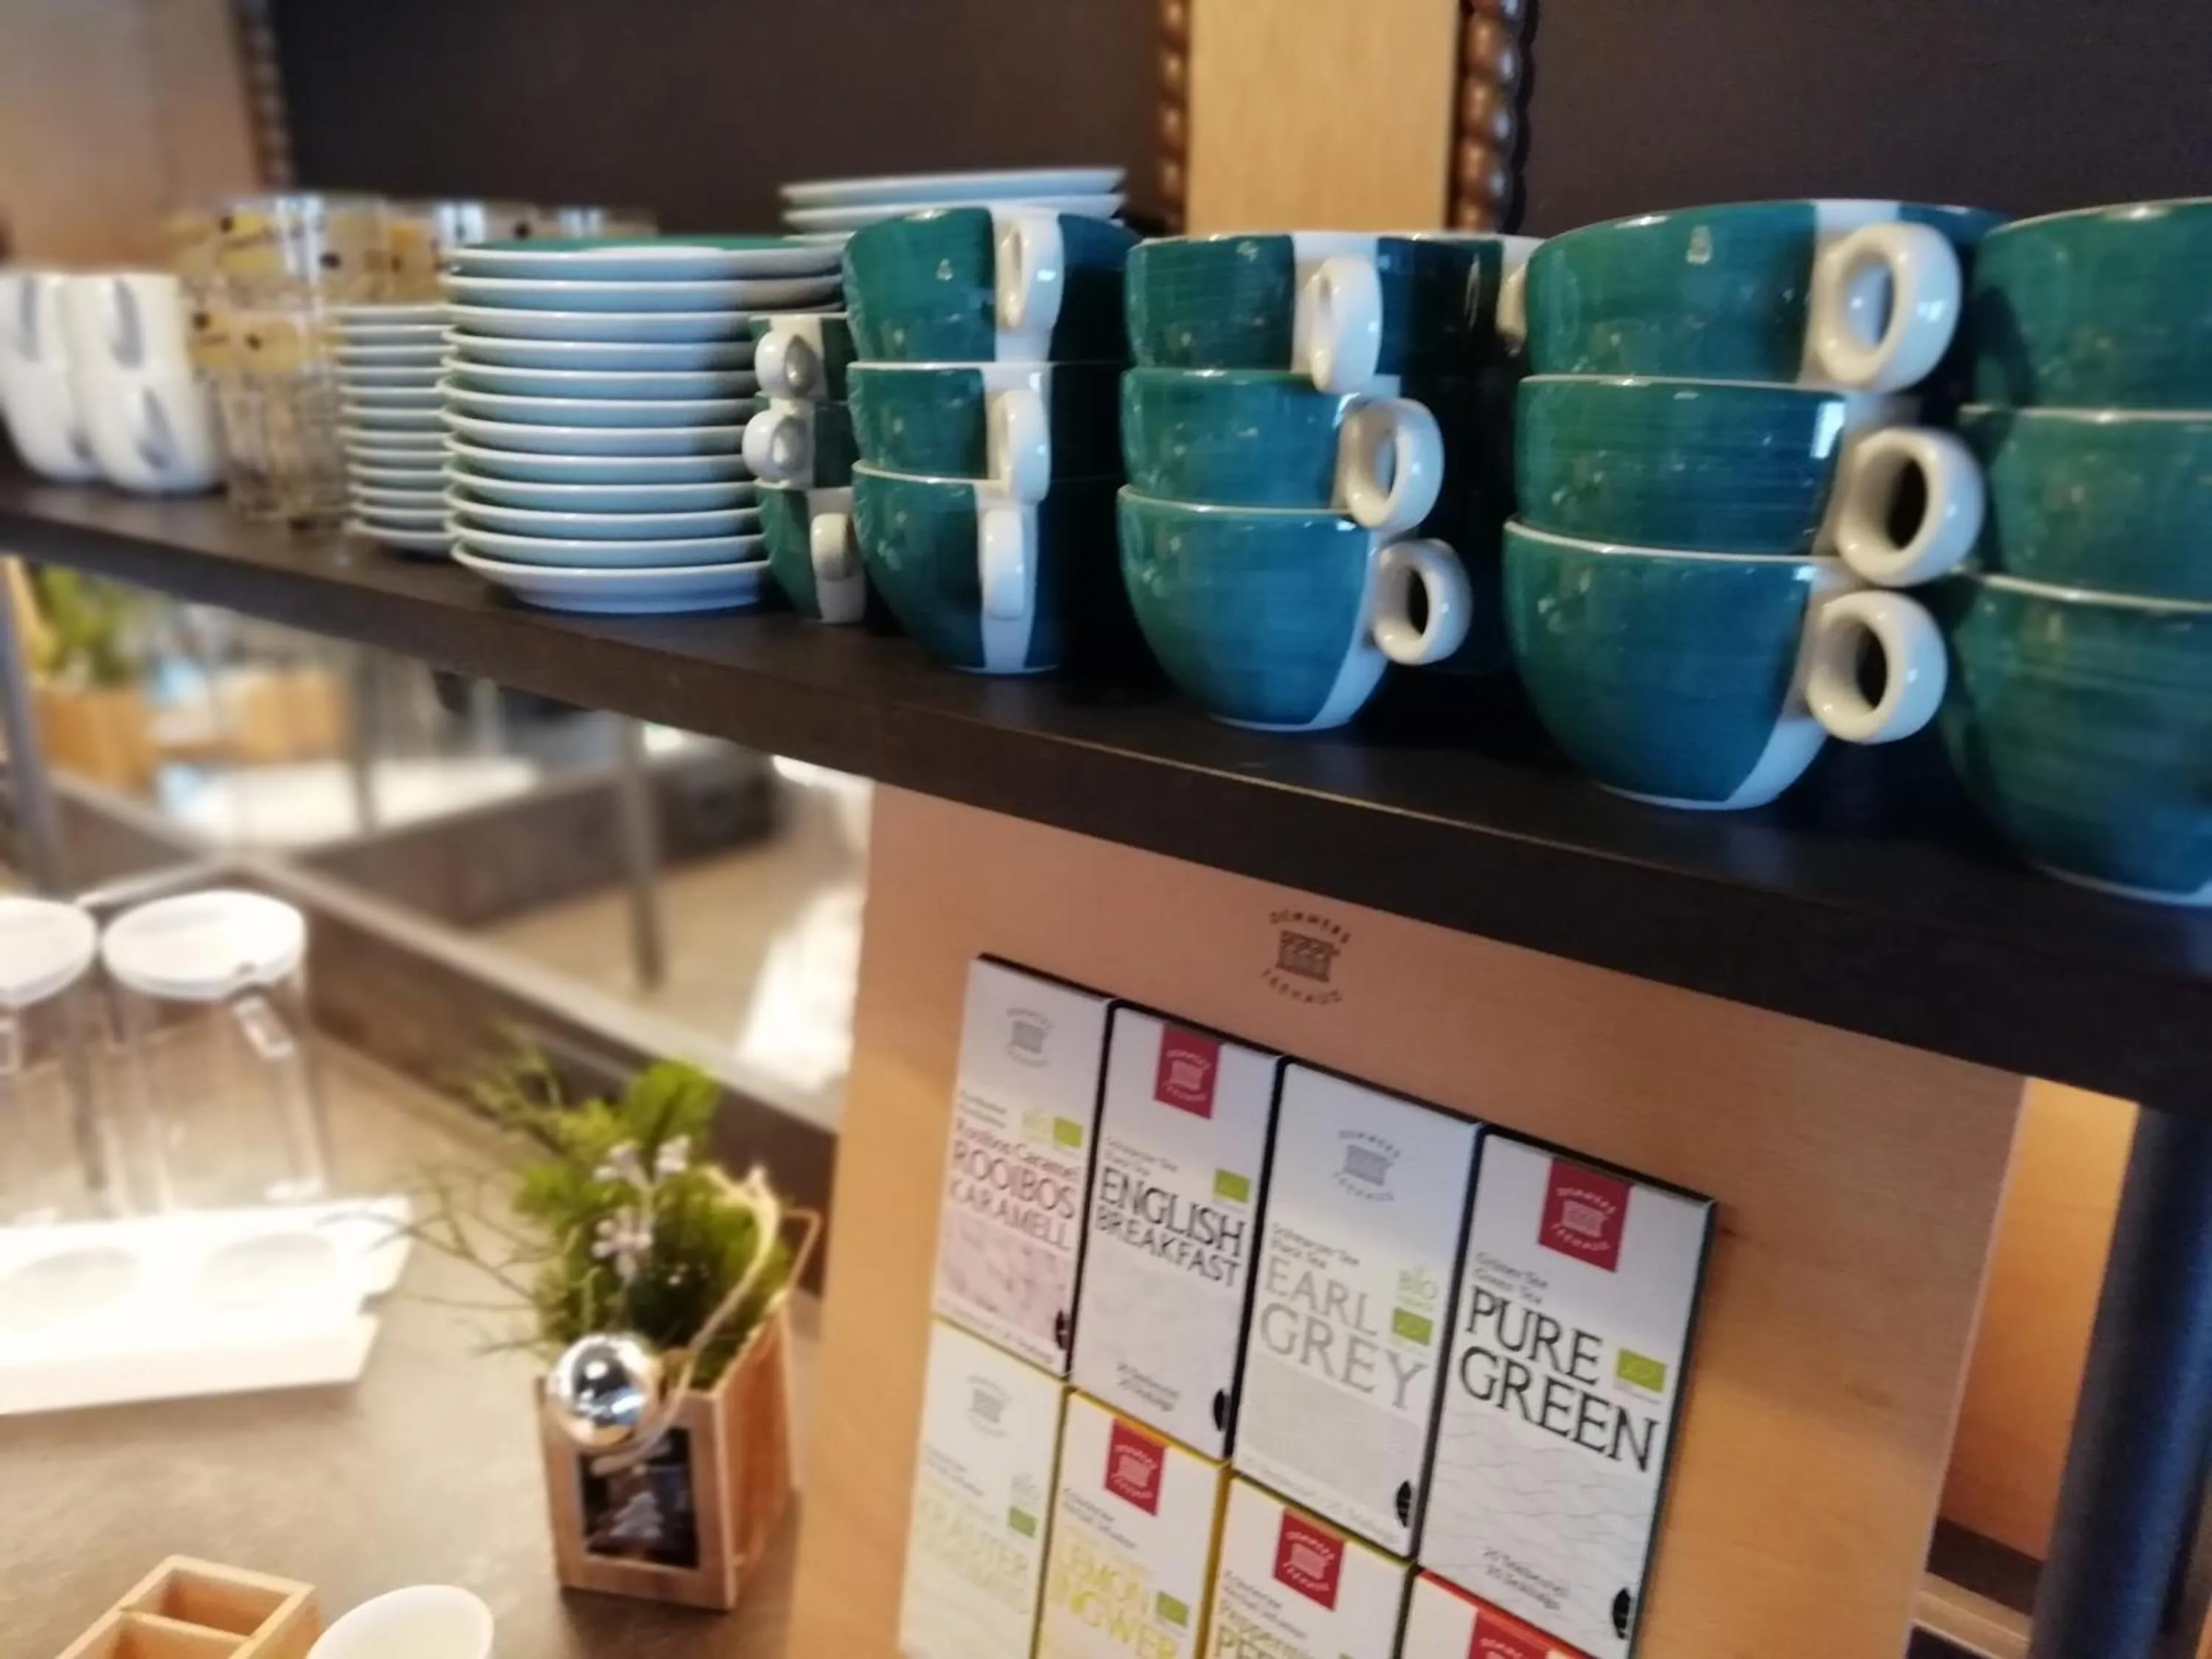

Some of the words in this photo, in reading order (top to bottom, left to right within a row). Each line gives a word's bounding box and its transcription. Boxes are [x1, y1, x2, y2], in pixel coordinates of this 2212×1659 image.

[952, 1139, 1078, 1220] ROOIBOS
[1100, 1166, 1248, 1257] ENGLISH
[1094, 1204, 1242, 1287] BREAKFAST
[1265, 1255, 1378, 1337] EARL
[1464, 1284, 1603, 1387] PURE
[1260, 1302, 1430, 1411] GREY
[1459, 1345, 1660, 1474] GREEN
